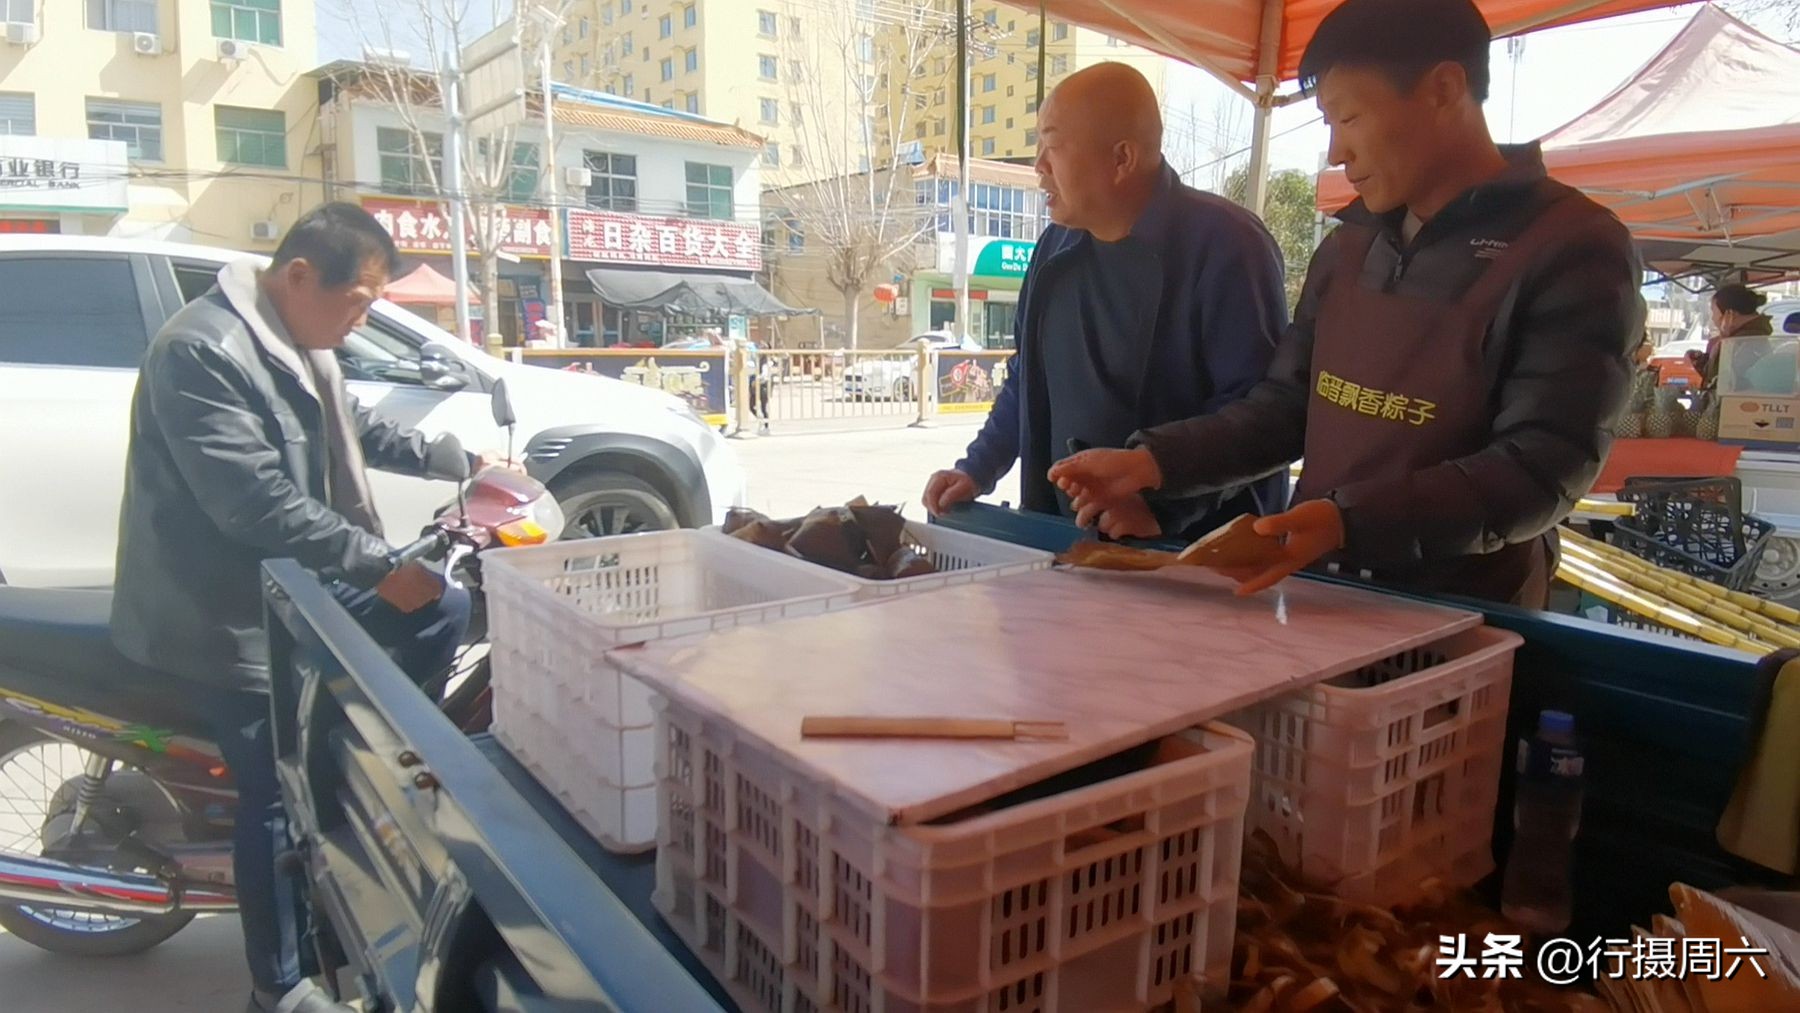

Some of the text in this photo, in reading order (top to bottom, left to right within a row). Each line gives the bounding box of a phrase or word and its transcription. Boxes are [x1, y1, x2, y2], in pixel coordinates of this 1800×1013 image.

[0, 158, 80, 179] 业银行
[48, 180, 80, 190] BANK
[603, 221, 755, 259] 日杂百货大全
